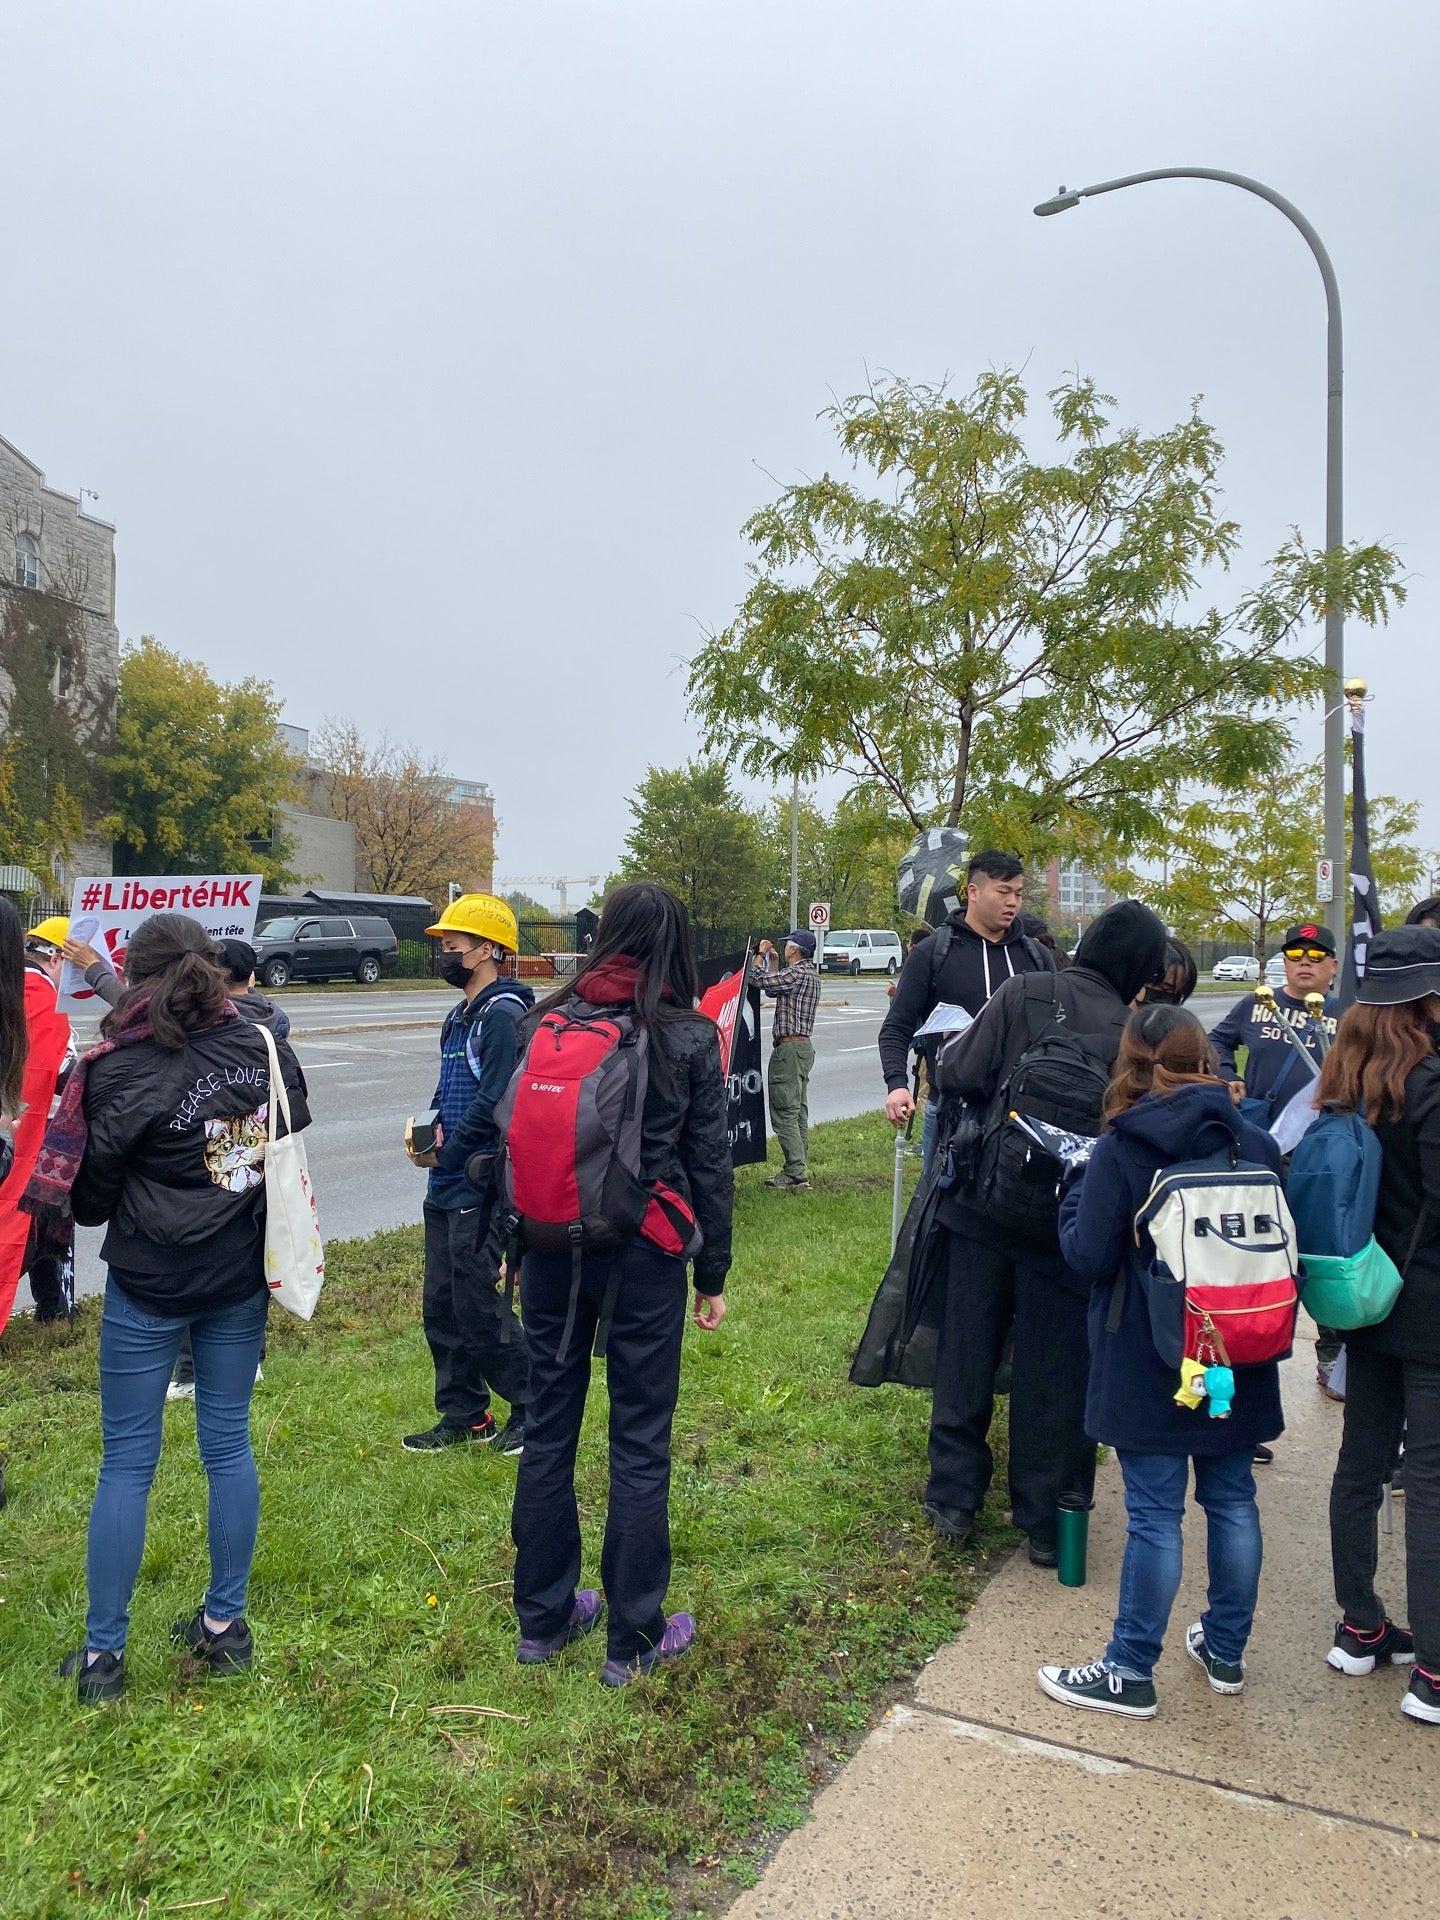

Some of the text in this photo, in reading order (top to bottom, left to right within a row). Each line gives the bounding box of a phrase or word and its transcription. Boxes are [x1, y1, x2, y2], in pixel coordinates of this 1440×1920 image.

[81, 880, 253, 911] #LibertéHK
[225, 924, 245, 936] tête
[1260, 1026, 1316, 1049] SO CL
[169, 1072, 221, 1131] PLEASE
[224, 1067, 266, 1087] LOVE
